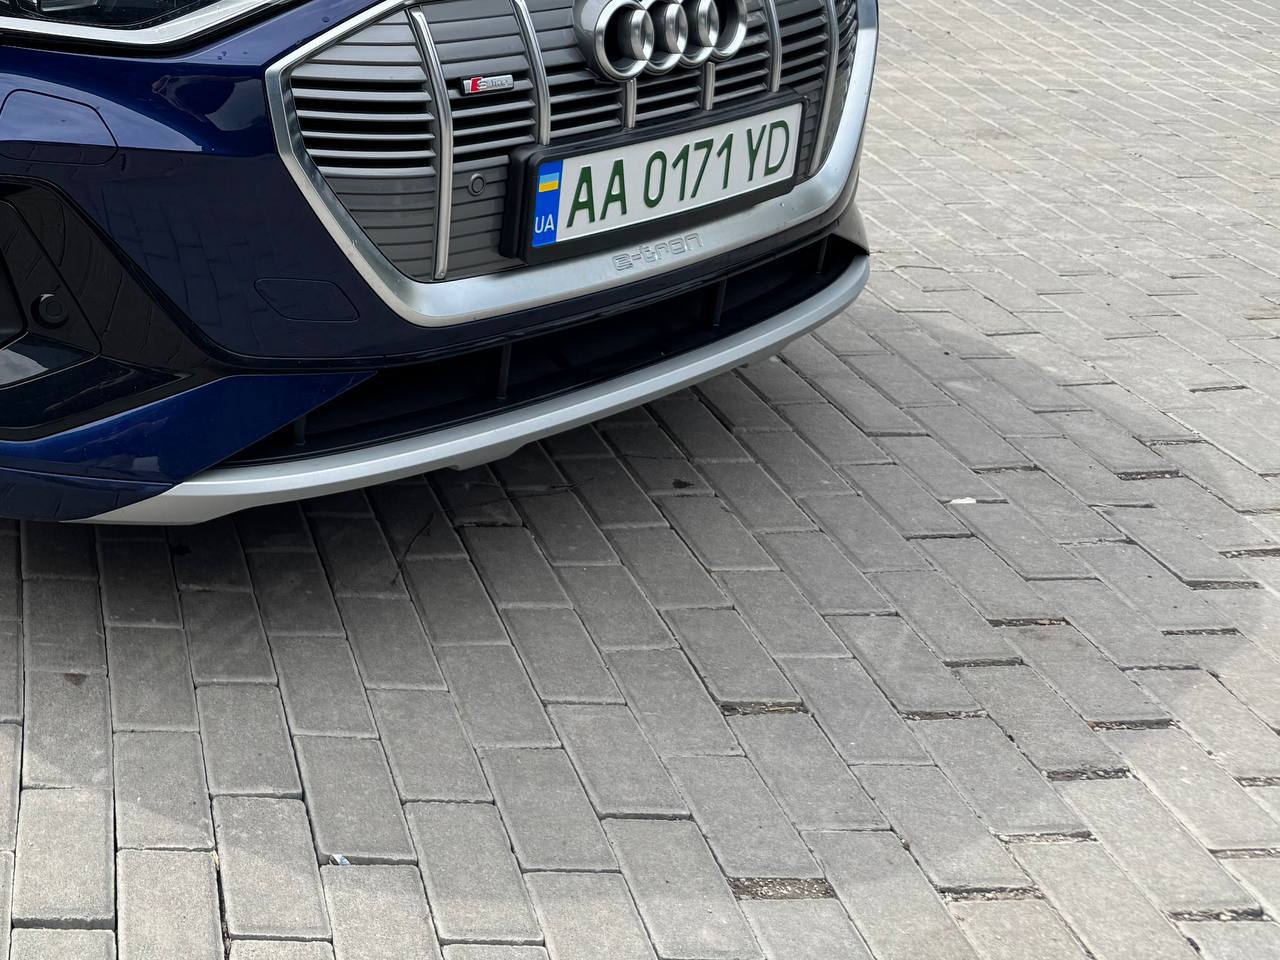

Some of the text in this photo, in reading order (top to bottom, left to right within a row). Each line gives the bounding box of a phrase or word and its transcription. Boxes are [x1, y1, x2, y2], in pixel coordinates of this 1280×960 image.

[566, 119, 790, 228] AA 0171 YD
[534, 214, 555, 234] UA
[612, 232, 705, 272] e-tron
